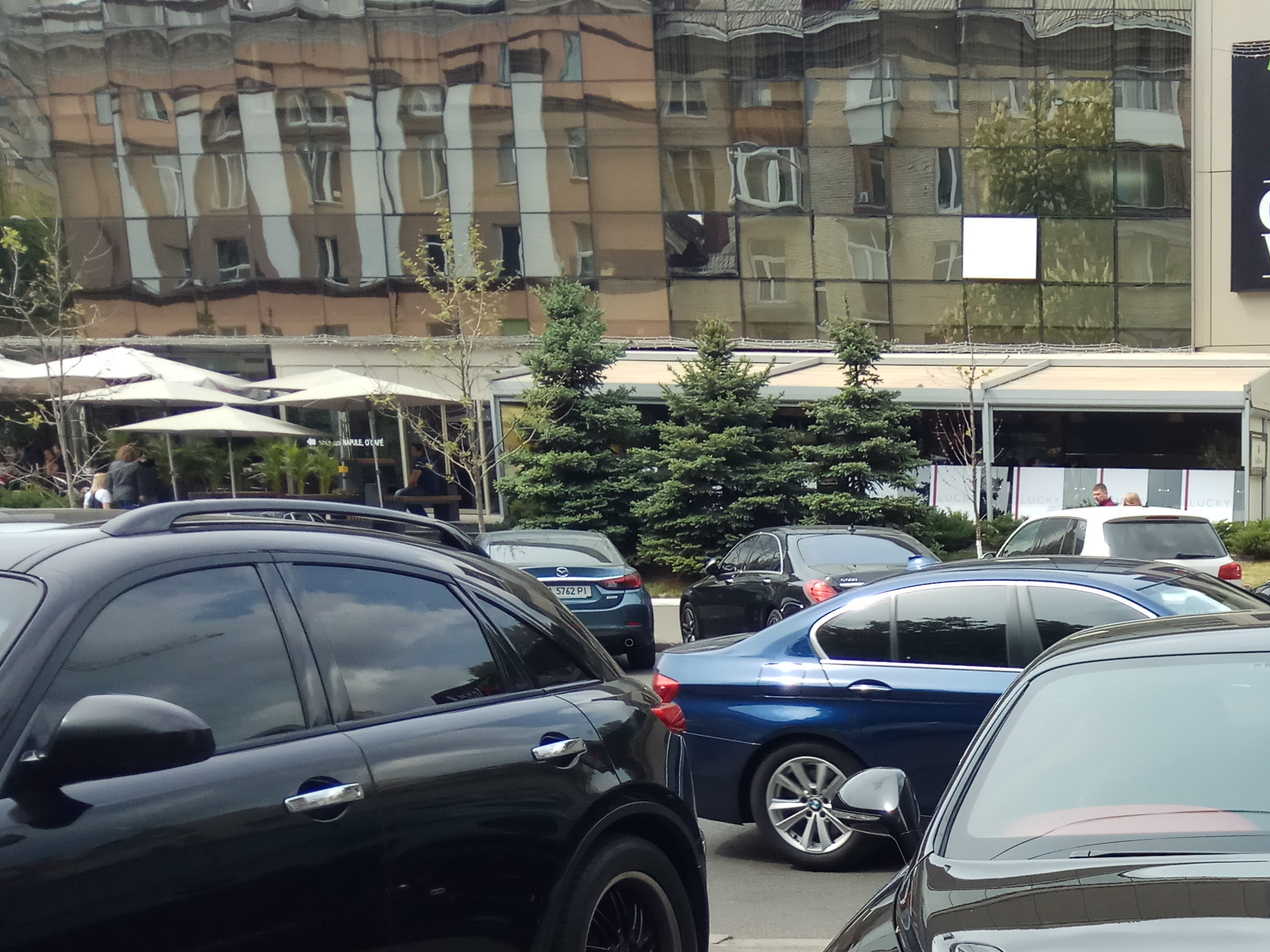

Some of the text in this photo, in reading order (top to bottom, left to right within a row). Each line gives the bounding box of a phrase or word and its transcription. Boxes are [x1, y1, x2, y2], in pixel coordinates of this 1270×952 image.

[1021, 495, 1060, 504] LUCKY
[1189, 498, 1231, 507] LUCKY
[556, 587, 575, 595] 5762
